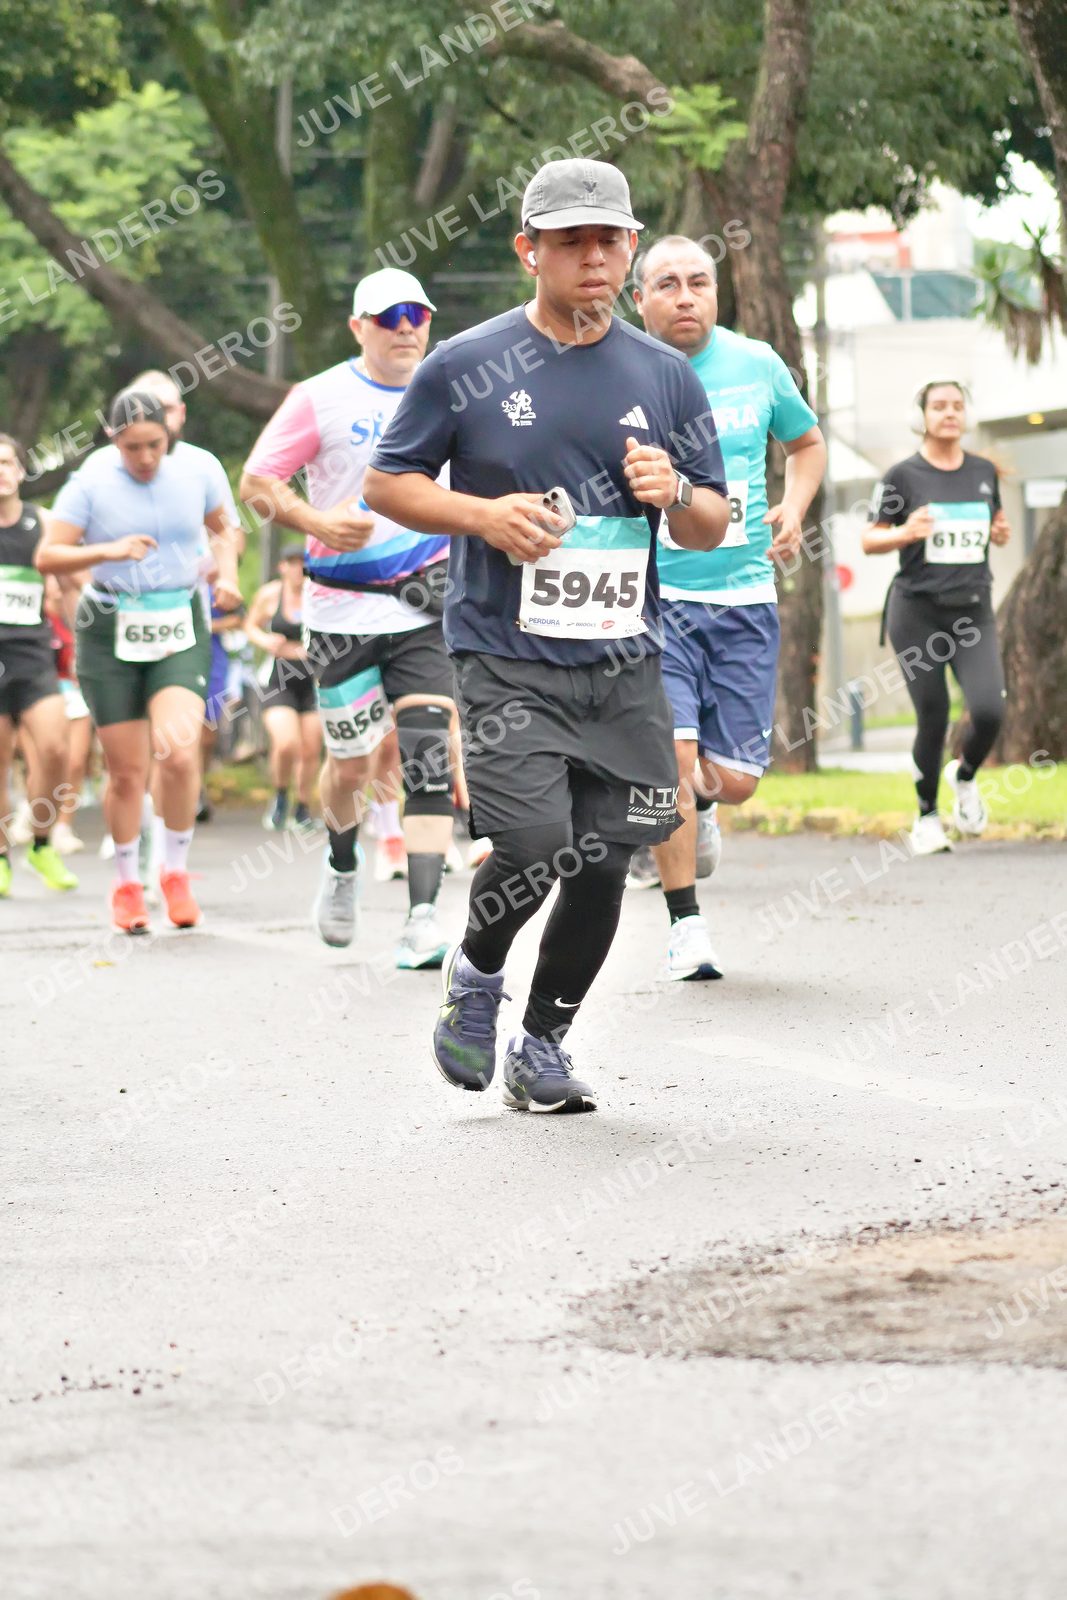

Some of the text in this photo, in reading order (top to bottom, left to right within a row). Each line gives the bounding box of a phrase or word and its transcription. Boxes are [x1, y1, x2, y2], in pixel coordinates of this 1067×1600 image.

[932, 530, 986, 548] 6152
[530, 569, 639, 608] 5945
[528, 617, 561, 626] PERDURA
[125, 623, 186, 643] 6596
[326, 700, 384, 740] 6856
